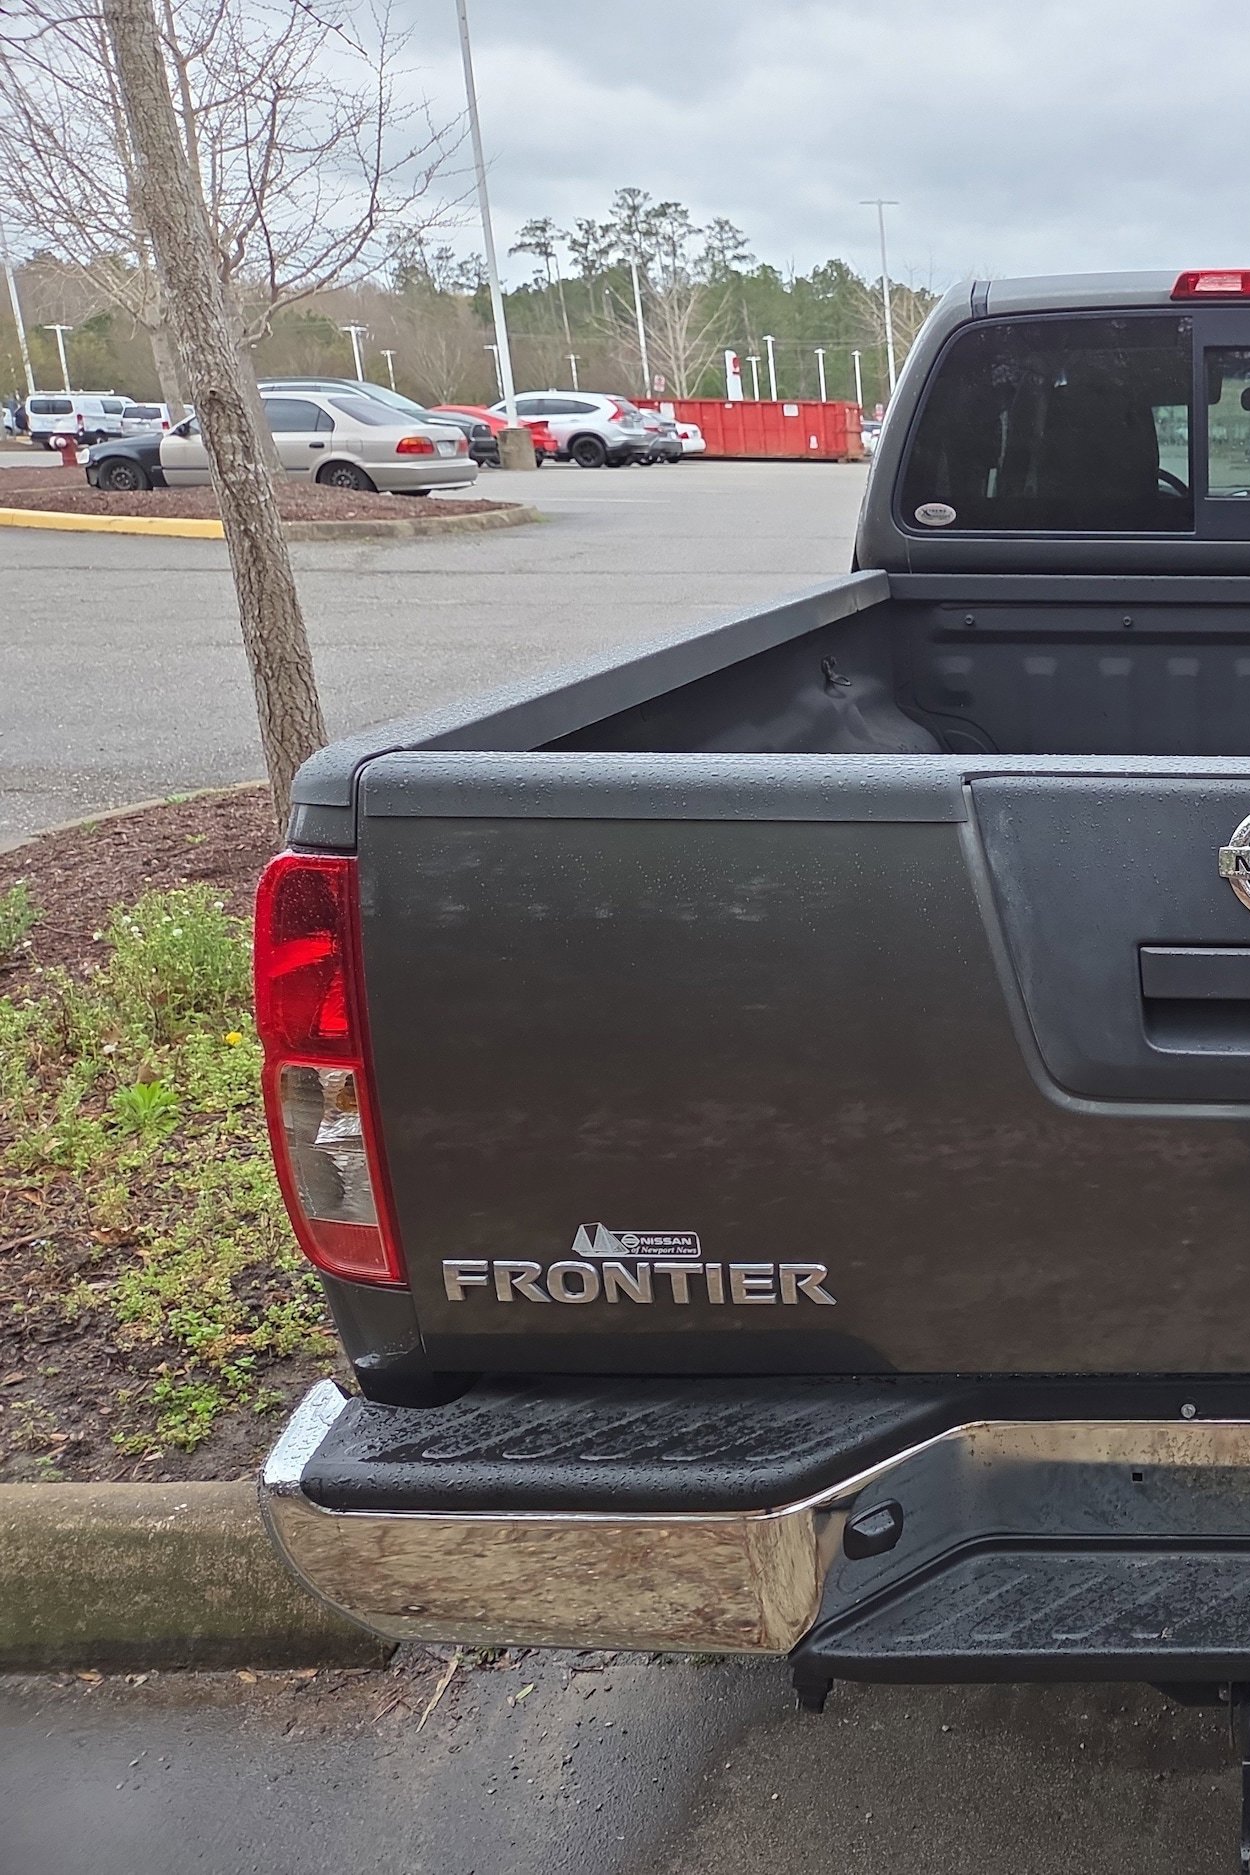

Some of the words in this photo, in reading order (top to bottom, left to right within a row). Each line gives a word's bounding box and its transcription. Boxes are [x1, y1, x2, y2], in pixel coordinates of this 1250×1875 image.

[640, 1237, 692, 1246] NISSAN
[631, 1246, 640, 1255] of
[641, 1246, 675, 1255] Newport
[676, 1246, 697, 1255] News
[442, 1259, 838, 1306] FRONTIER
